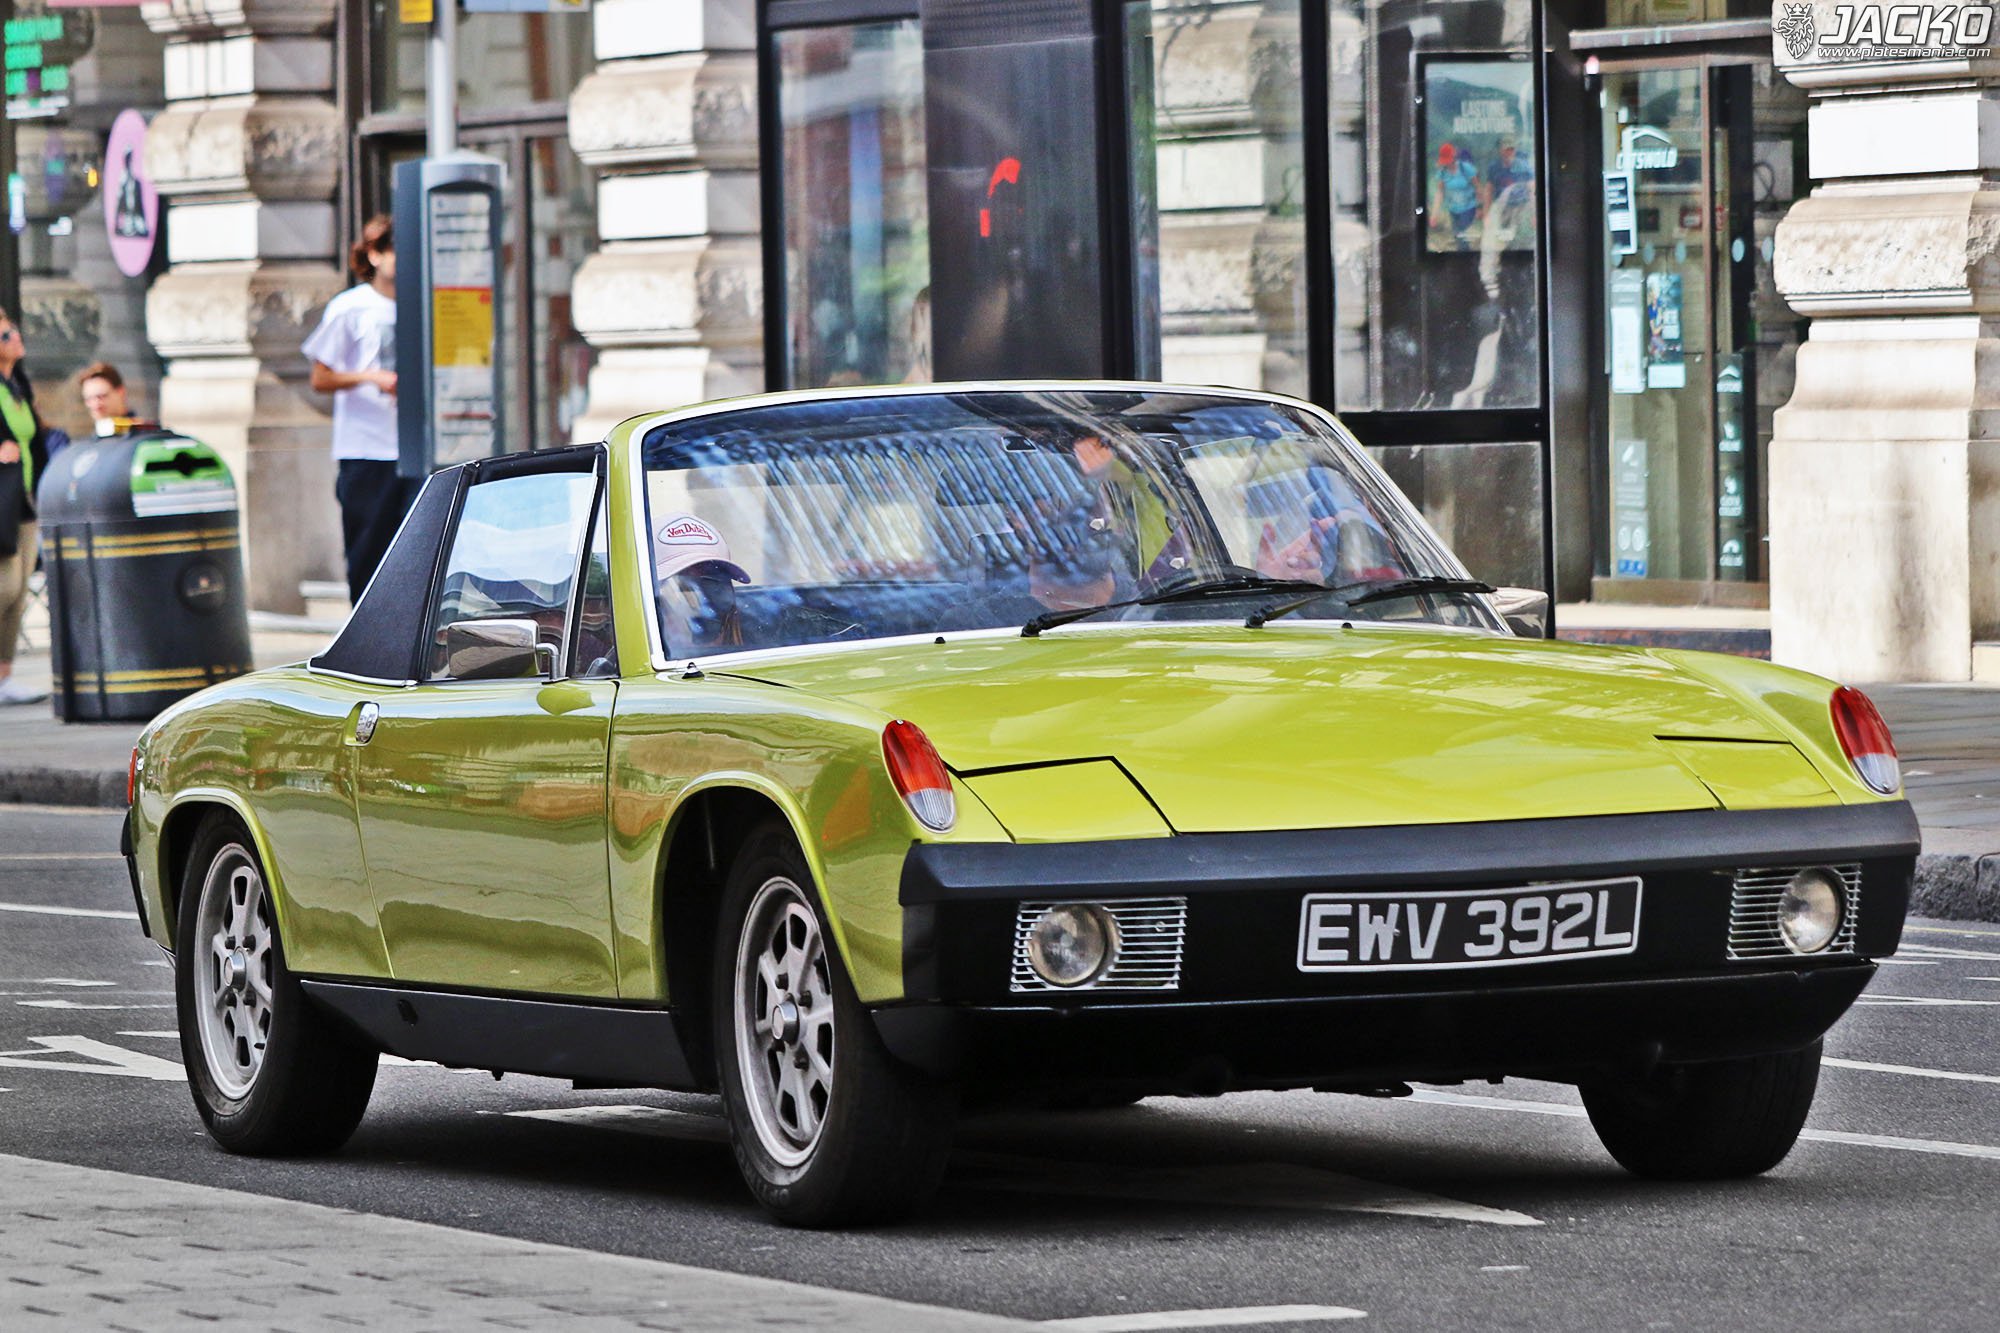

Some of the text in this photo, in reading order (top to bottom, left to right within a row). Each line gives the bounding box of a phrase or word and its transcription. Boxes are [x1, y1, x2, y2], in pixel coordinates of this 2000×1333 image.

[1453, 116, 1515, 133] ADVENTURE
[1306, 890, 1633, 962] EWV 392L
